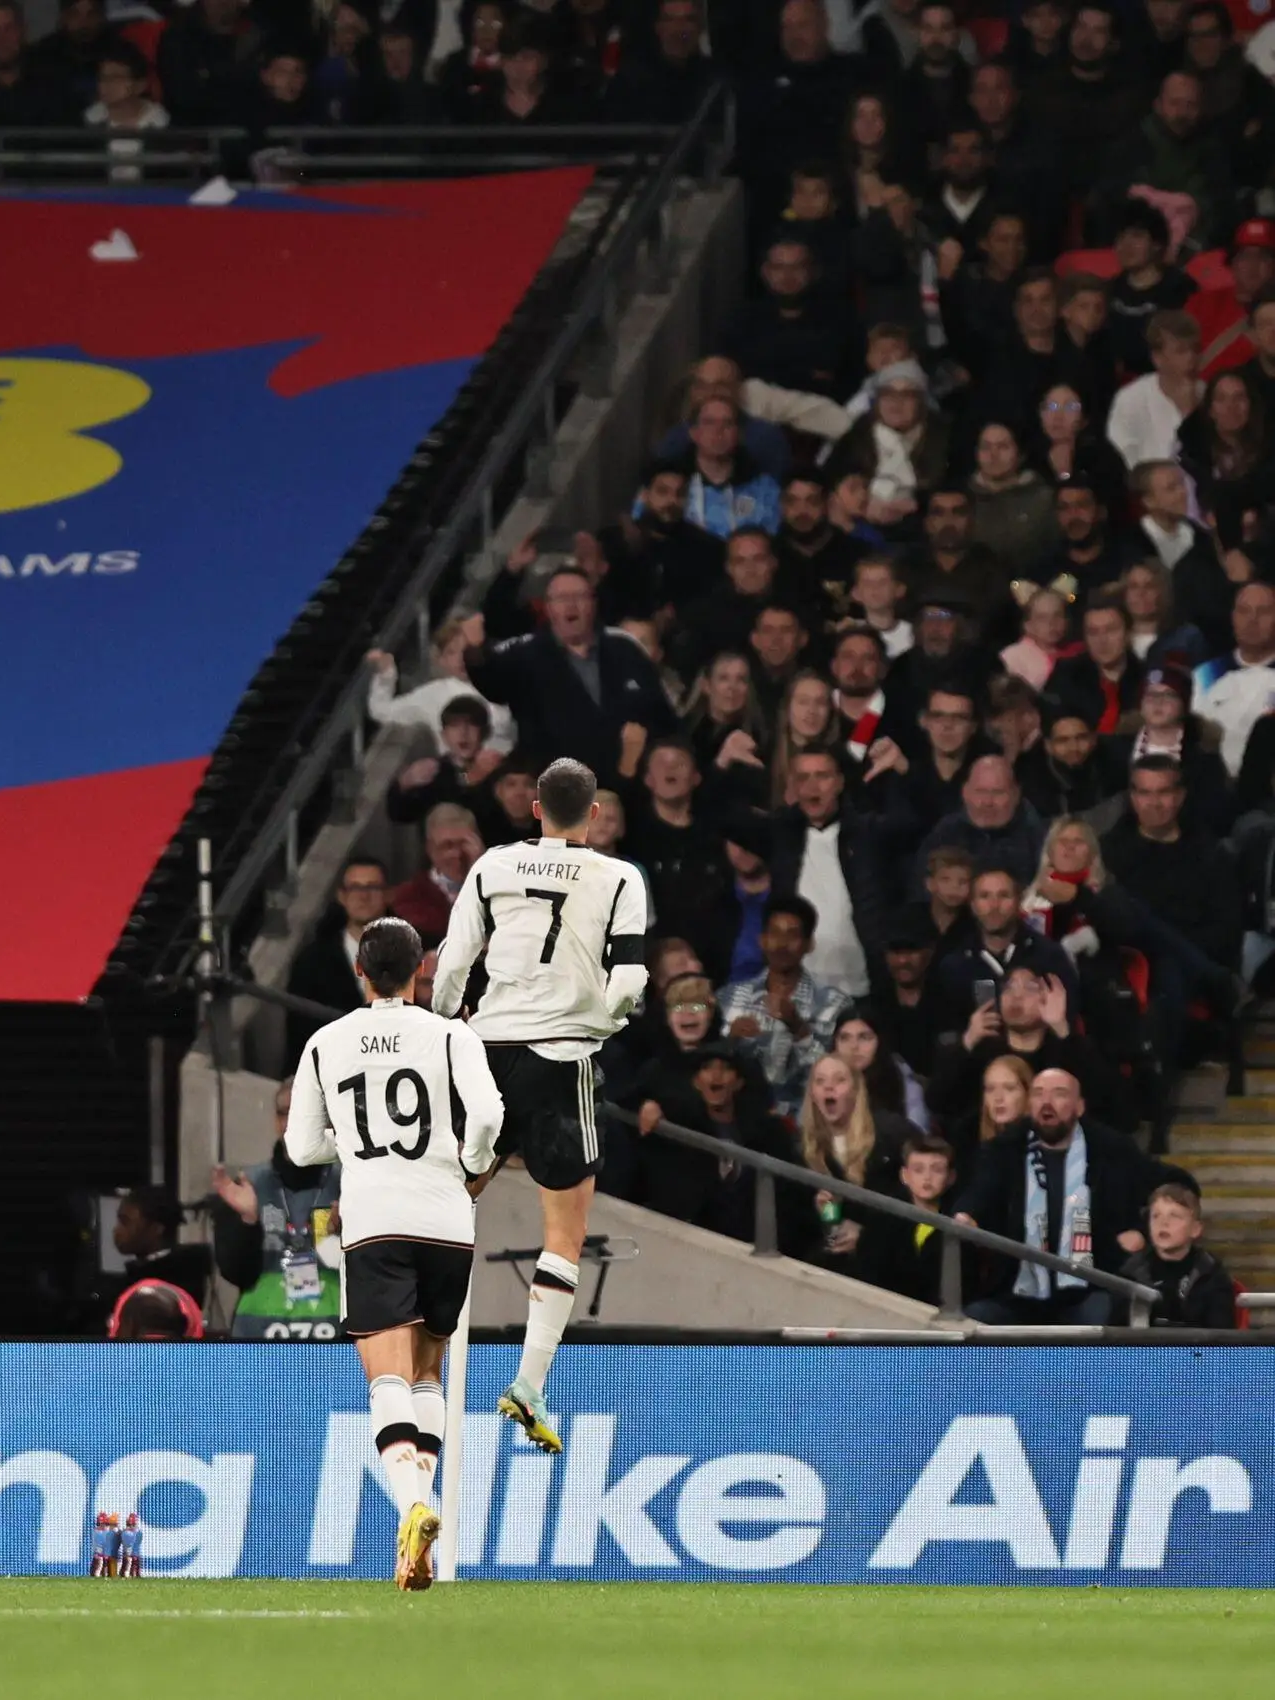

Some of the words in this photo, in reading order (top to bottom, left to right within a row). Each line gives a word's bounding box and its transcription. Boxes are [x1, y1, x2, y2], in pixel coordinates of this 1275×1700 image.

[516, 861, 582, 881] HAVERTZ
[525, 887, 569, 964] 7
[360, 1032, 401, 1054] SANÉ
[337, 1068, 432, 1160] 19
[307, 1411, 826, 1571] Nike
[867, 1413, 1253, 1571] Air
